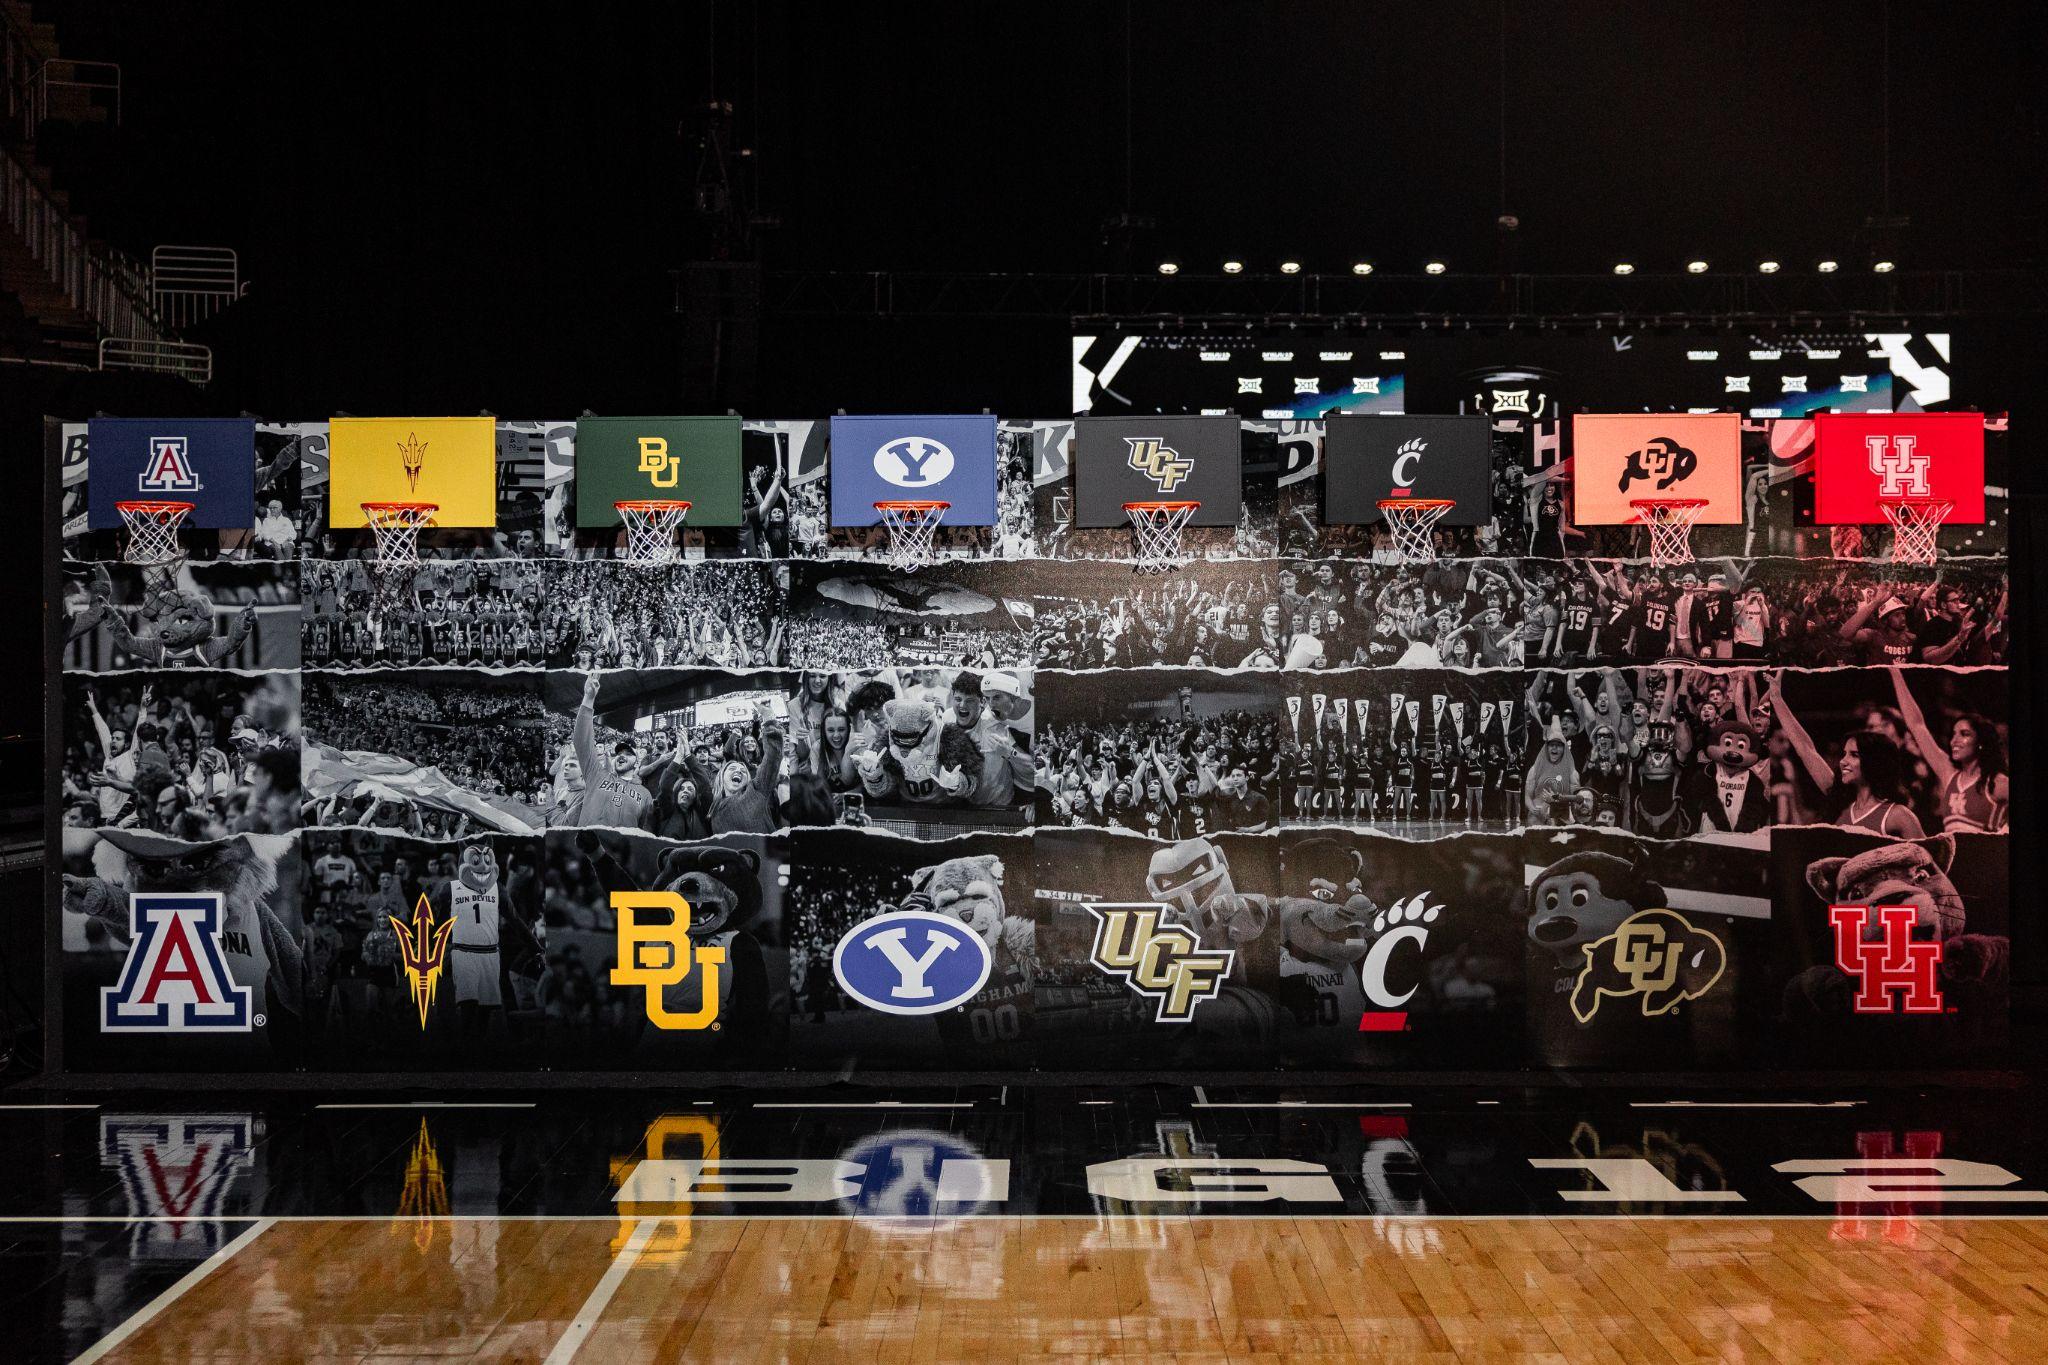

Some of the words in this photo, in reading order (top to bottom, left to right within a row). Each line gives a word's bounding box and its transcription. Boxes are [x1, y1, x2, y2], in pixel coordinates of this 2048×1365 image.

[1499, 394, 1523, 408] XII
[138, 436, 199, 492] A
[637, 437, 681, 488] BU
[886, 441, 942, 482] Y
[1124, 438, 1195, 493] UCF
[1391, 450, 1421, 488] C
[1865, 434, 1931, 497] UH
[1567, 610, 1589, 631] 19
[1608, 605, 1624, 626] 7
[1645, 608, 1667, 631] 19
[599, 779, 642, 806] BAYLOR
[1724, 792, 1734, 808] 6
[455, 895, 468, 905] SUN
[471, 893, 496, 905] DEVILS
[472, 902, 481, 925] 1
[100, 892, 253, 1033] A
[609, 891, 726, 1030] BU
[863, 926, 961, 999] Y
[1088, 905, 1232, 1019] UCF
[1362, 925, 1429, 1008] C
[1613, 923, 1684, 992] CU
[1828, 904, 1944, 1015] UH
[969, 1003, 1021, 1043] 00
[611, 1158, 1345, 1202] BIG
[1527, 1158, 2048, 1203] 12
